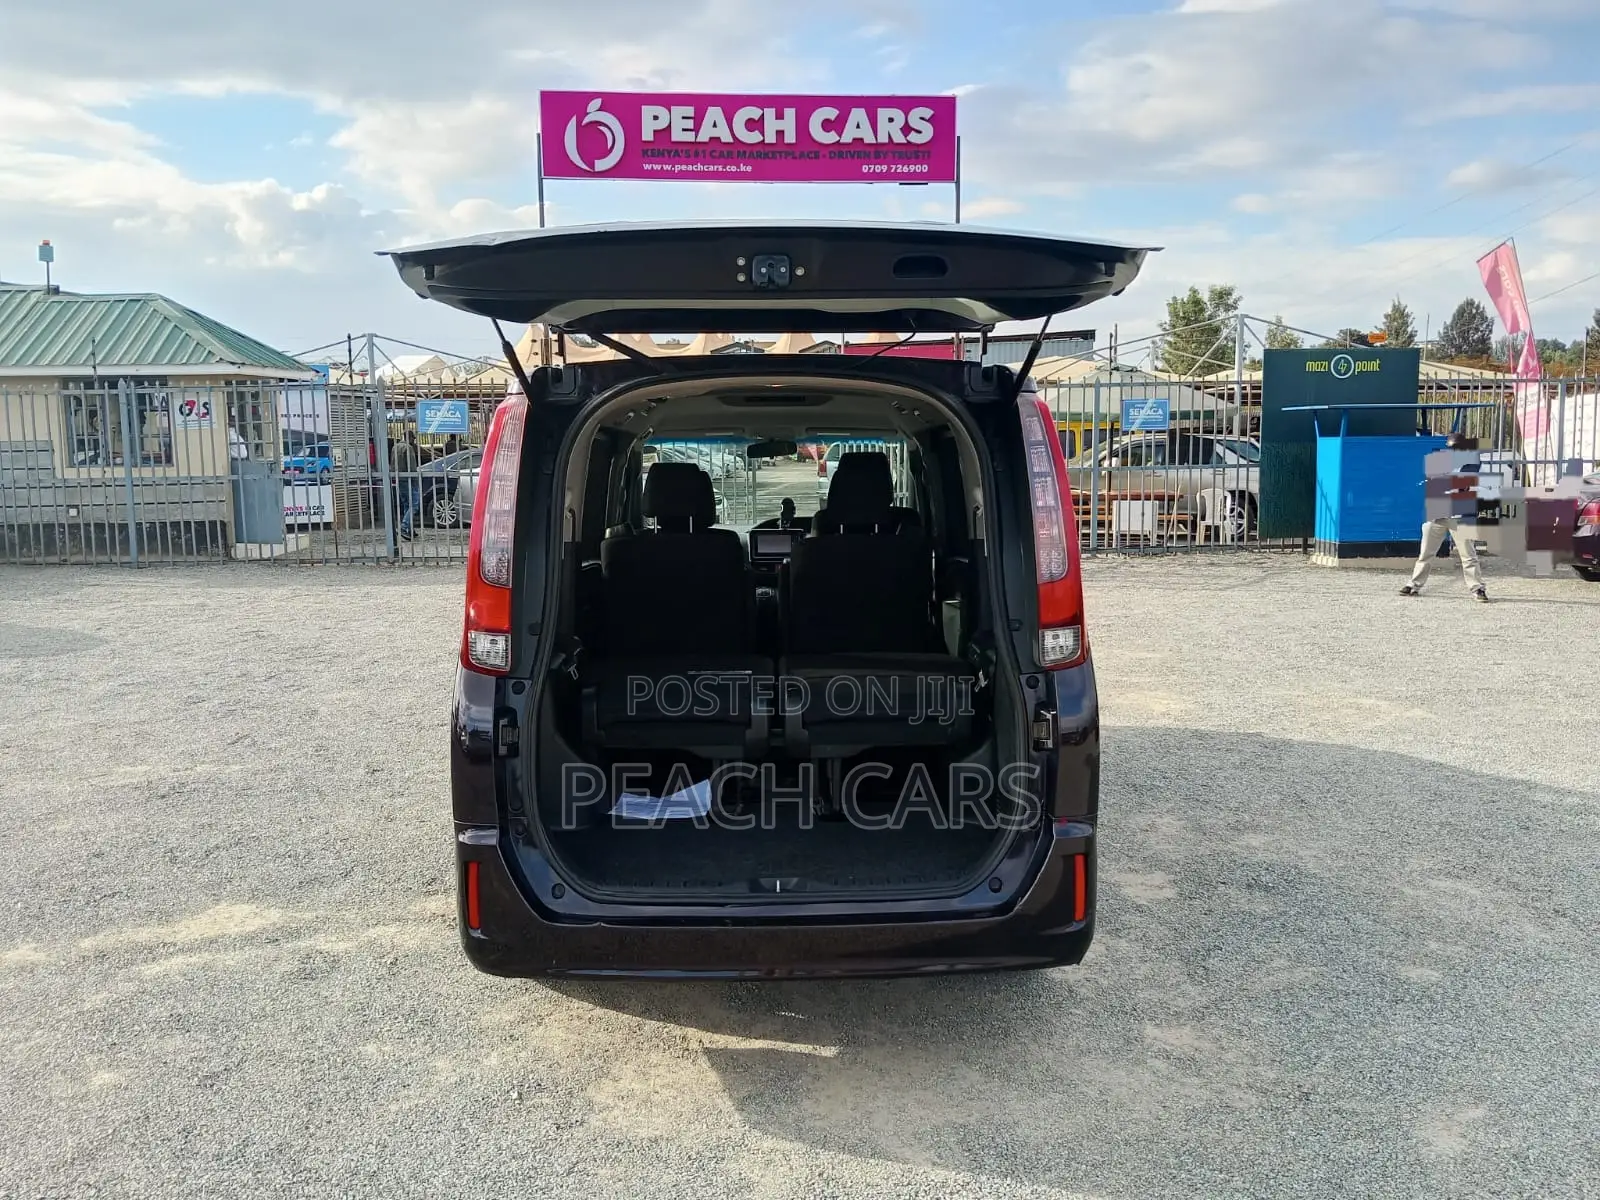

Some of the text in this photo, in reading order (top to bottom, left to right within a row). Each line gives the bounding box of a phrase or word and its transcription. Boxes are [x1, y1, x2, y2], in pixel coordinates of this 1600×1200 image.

[640, 104, 935, 145] PEACH CARS
[641, 148, 691, 159] KENYA'S
[693, 149, 707, 159] #1
[709, 149, 733, 160] CAR
[736, 149, 820, 160] MARKETPLACE
[828, 150, 871, 160] DRIVEN
[874, 150, 888, 160] BY
[642, 162, 928, 173] www.peachcars.co.ke 0709 726900
[1305, 361, 1329, 372] mazi
[1354, 359, 1381, 375] point
